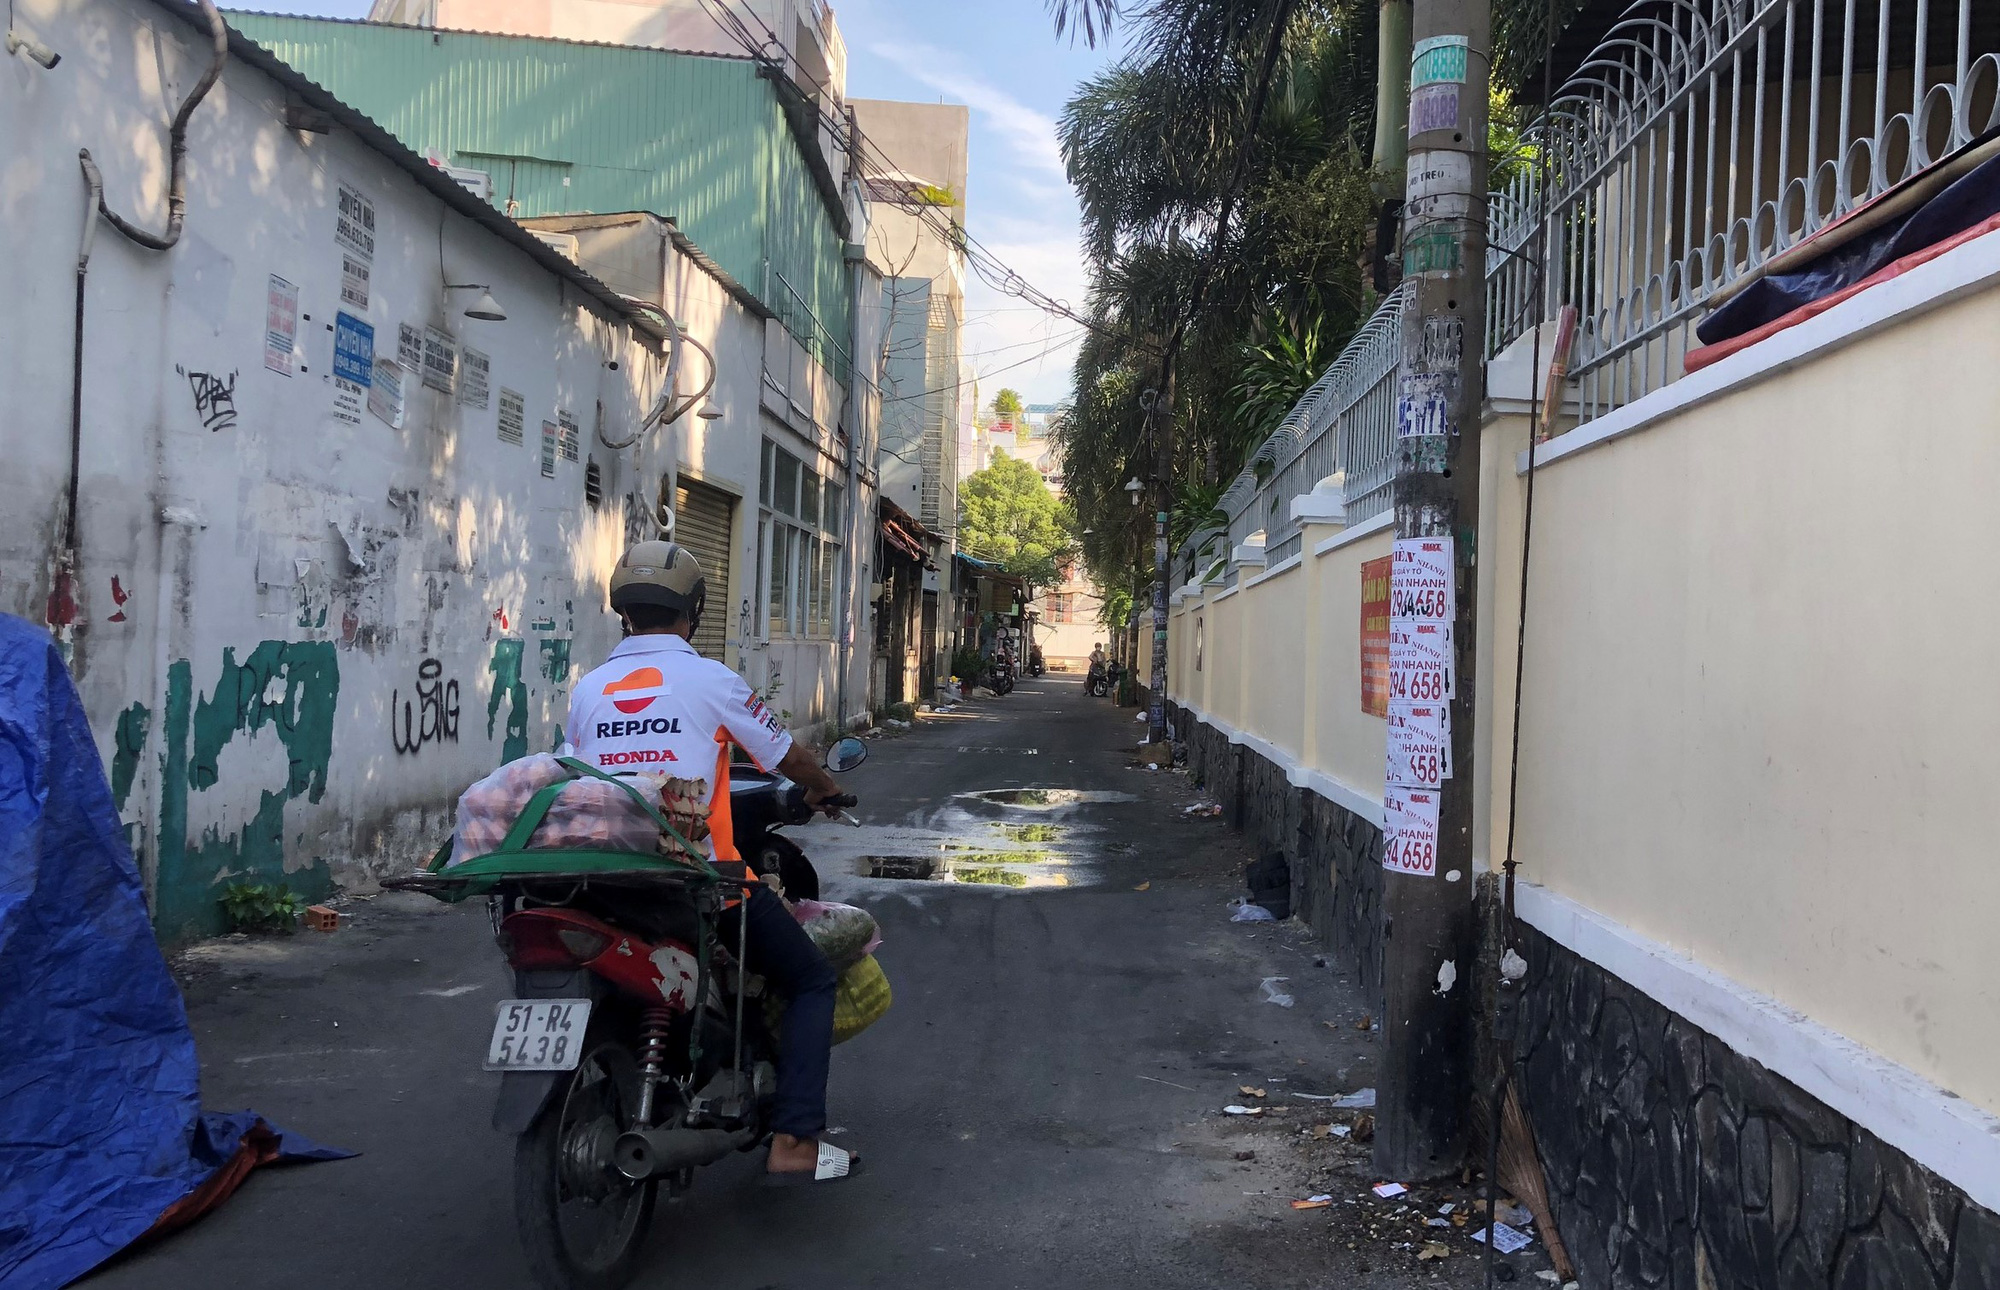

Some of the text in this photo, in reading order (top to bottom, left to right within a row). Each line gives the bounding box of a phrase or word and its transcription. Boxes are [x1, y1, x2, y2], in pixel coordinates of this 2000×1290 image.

[1416, 559, 1446, 577] NHANH
[1406, 578, 1446, 588] NHANH
[1412, 641, 1441, 659] NHANH
[1402, 660, 1441, 670] NHANH
[1411, 672, 1441, 700] 658
[597, 718, 682, 739] REPSOL
[1408, 724, 1437, 742] NHANH
[599, 749, 679, 766] HONDA
[1402, 841, 1432, 871] 658
[506, 1005, 573, 1032] 51-R4
[497, 1036, 569, 1066] 5438
